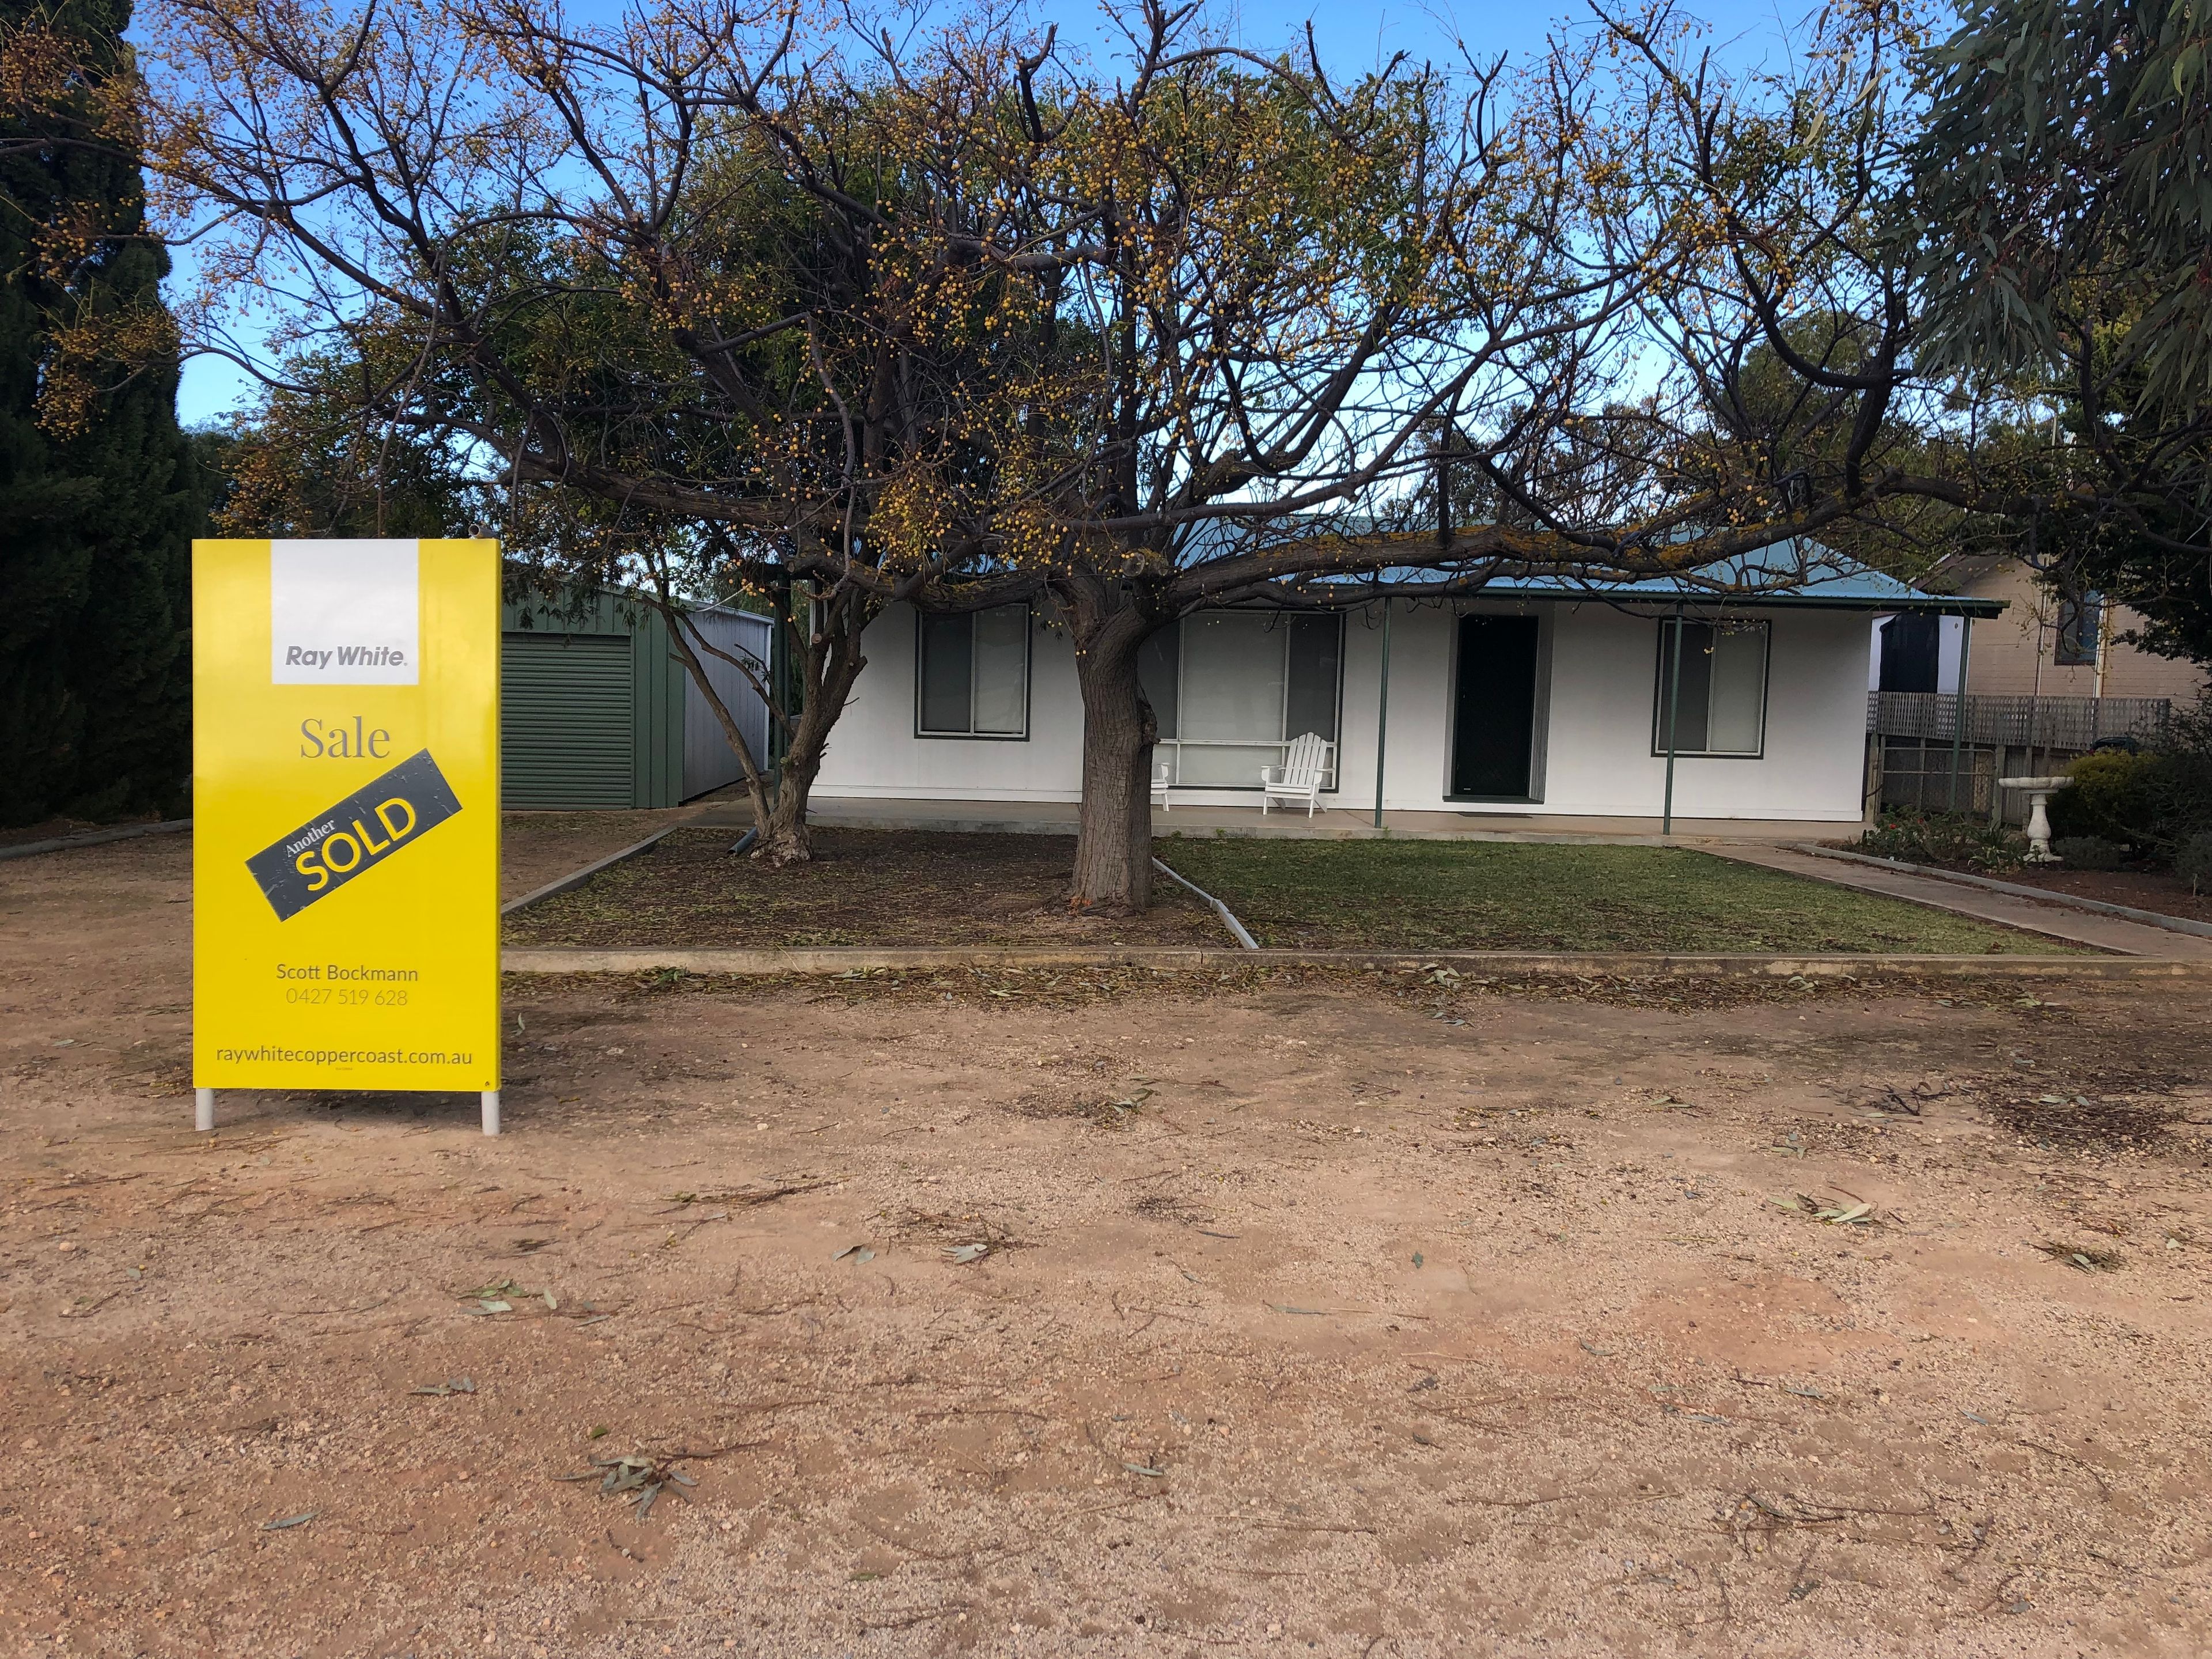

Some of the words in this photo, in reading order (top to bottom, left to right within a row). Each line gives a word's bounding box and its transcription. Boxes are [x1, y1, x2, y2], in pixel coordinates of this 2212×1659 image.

[286, 645, 333, 669] Ray
[300, 715, 391, 759] Sale
[285, 819, 336, 858] Another
[295, 797, 416, 891] SOLD
[276, 963, 321, 980] Scott
[327, 964, 418, 982] Bockmann
[286, 987, 332, 1005] 0427
[337, 988, 369, 1005] 519
[374, 990, 408, 1006] 628
[217, 1045, 472, 1066] raywhitecoppercoast.com.au
